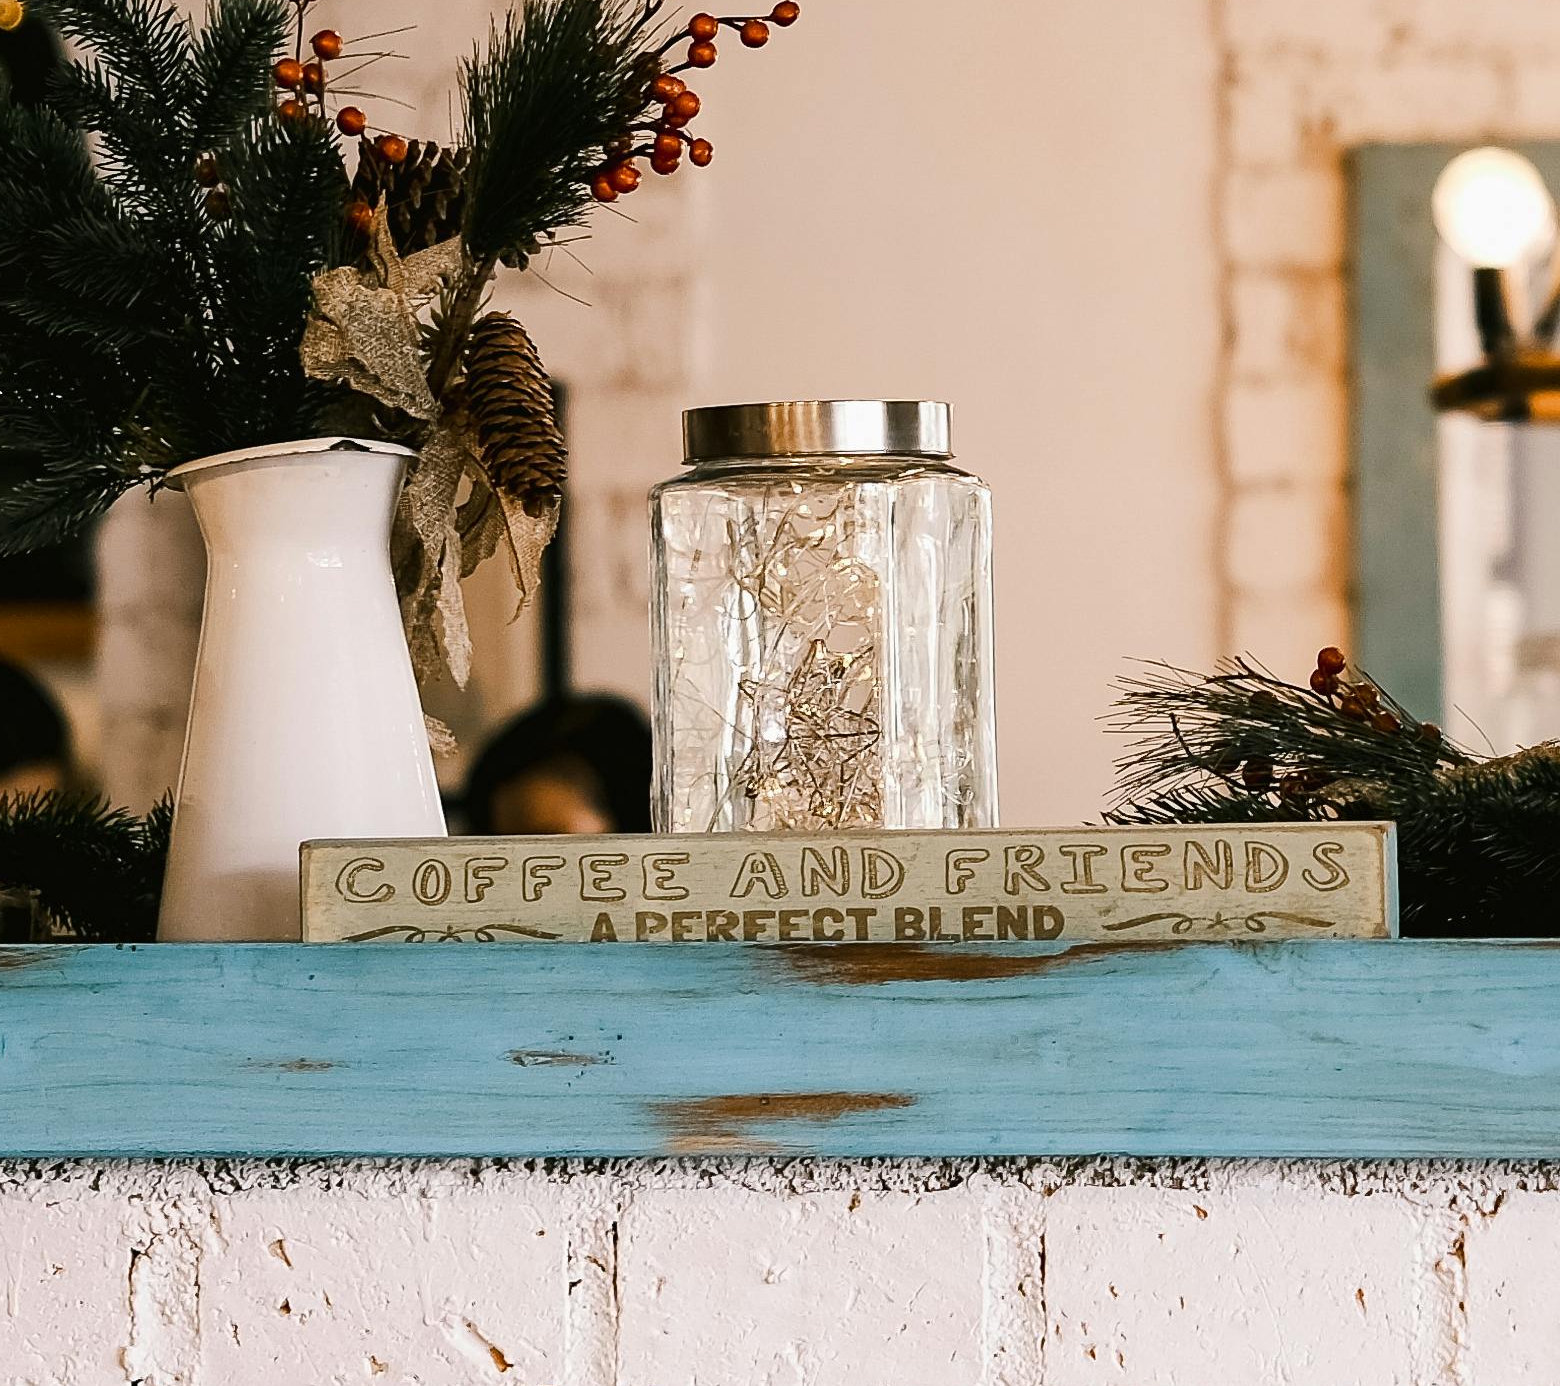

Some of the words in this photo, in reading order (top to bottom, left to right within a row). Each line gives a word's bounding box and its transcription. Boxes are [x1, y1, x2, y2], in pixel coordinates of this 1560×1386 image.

[335, 851, 691, 906] COFFEE
[729, 845, 907, 900] AND
[945, 838, 1351, 896] FRIENDS
[589, 911, 620, 943] A
[635, 906, 878, 943] PERFECT
[893, 903, 1066, 942] BLEND
